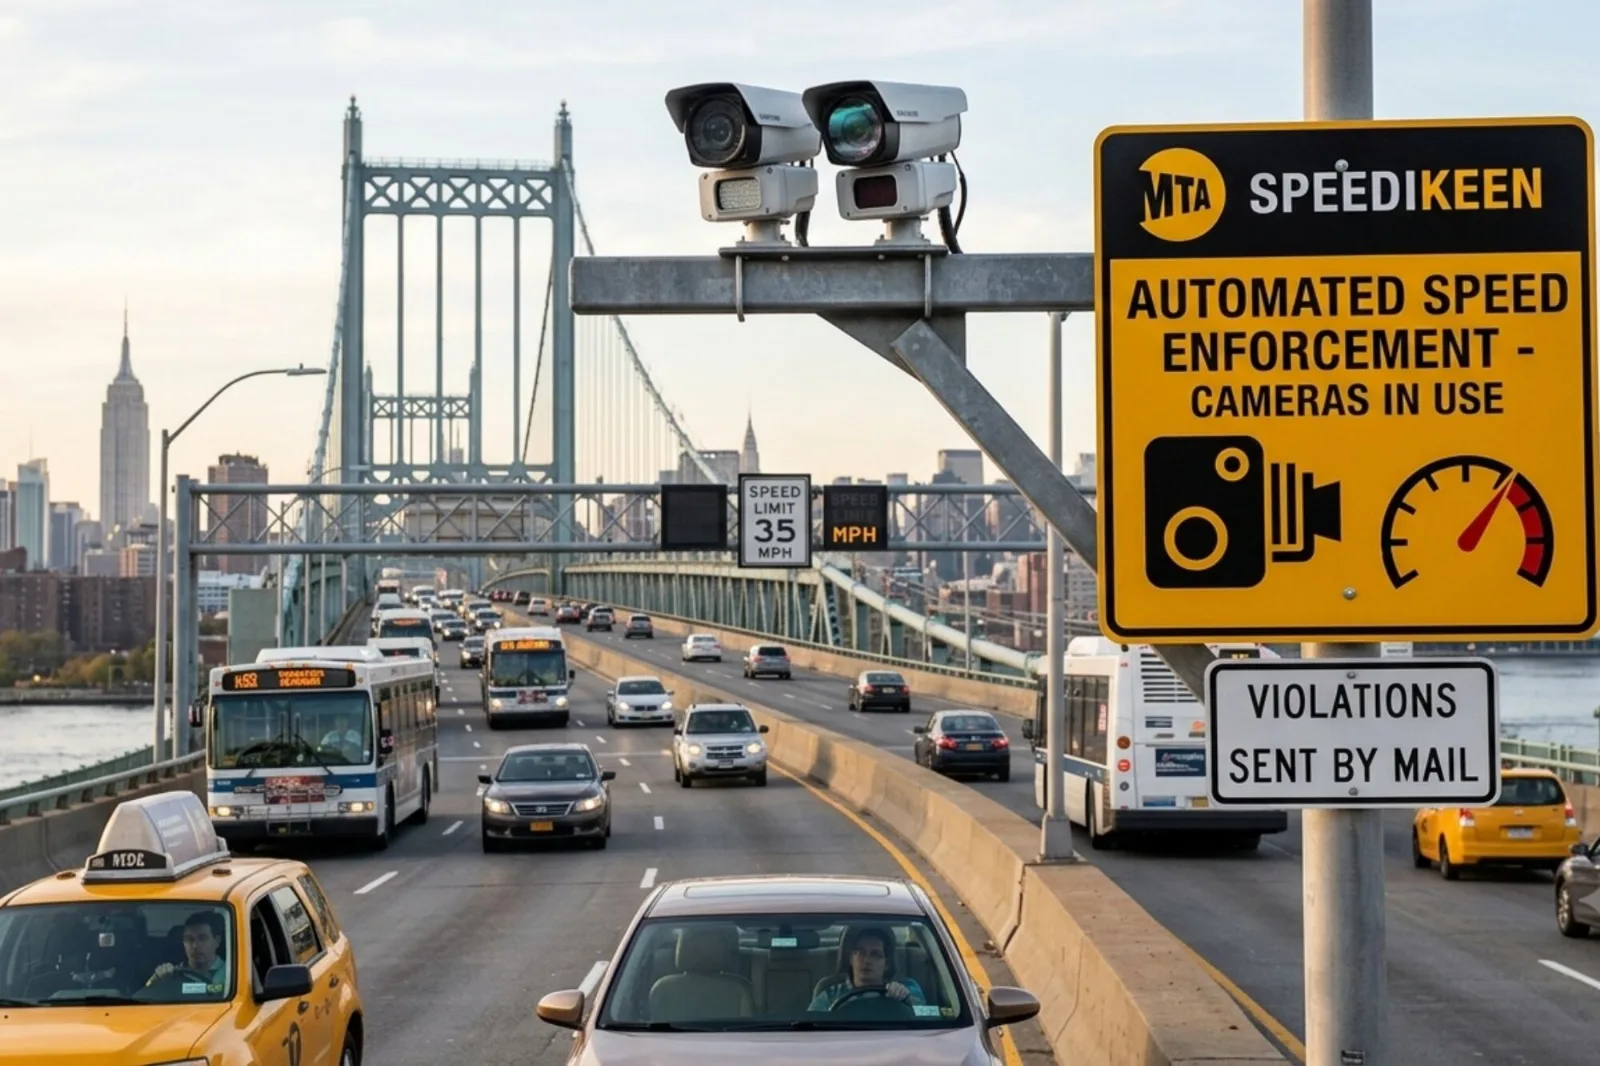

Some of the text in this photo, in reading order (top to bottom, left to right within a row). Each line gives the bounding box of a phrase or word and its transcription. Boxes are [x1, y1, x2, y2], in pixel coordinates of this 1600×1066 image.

[1141, 170, 1212, 222] MTA
[1250, 168, 1542, 214] SPEEDIKEEN
[1127, 273, 1569, 320] AUTOMATED SPEED
[1163, 328, 1500, 373] ENFORCEMENT
[1191, 382, 1504, 418] CAMERAS IN USE
[749, 485, 801, 498] SPEED
[754, 502, 796, 514] LIMIT
[754, 519, 796, 543] 35
[833, 526, 876, 543] MPH
[758, 547, 792, 559] MPH
[1247, 683, 1457, 719] VIOLATIONS
[1229, 747, 1479, 784] SENT BY MAIL
